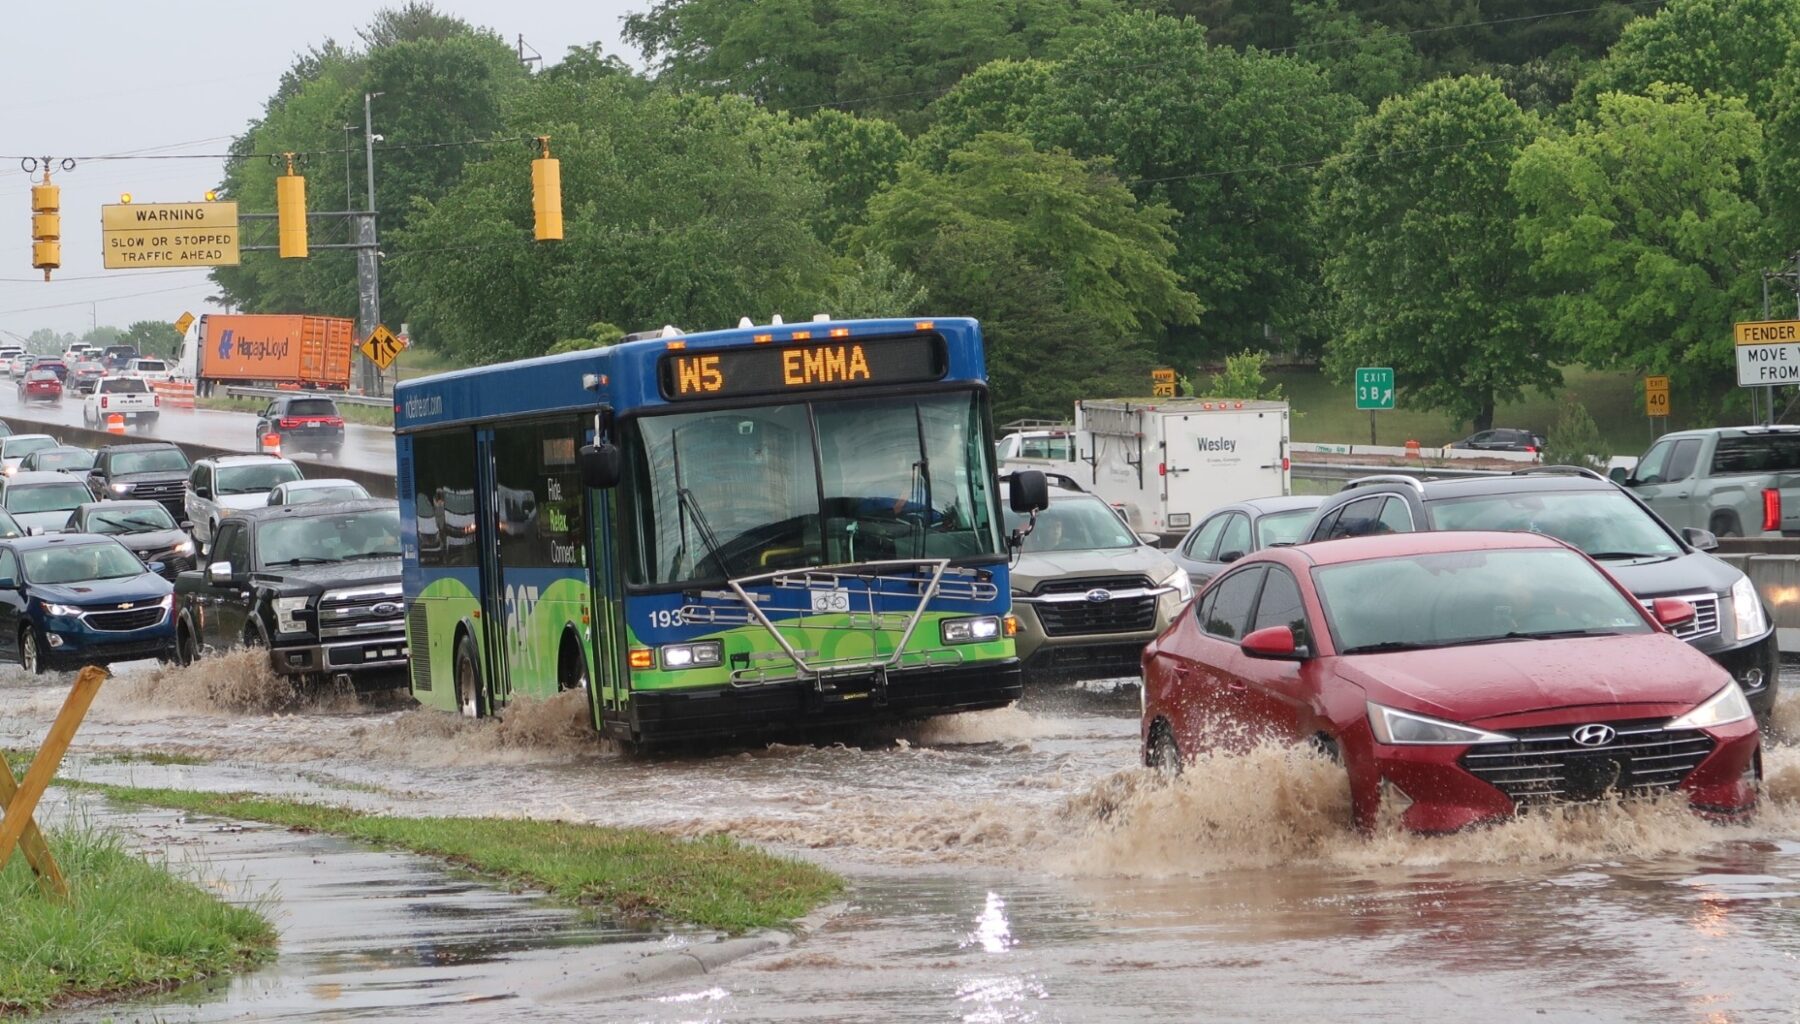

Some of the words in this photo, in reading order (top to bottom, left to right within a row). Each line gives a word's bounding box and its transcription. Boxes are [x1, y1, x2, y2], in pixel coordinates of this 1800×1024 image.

[136, 208, 205, 222] WARNING
[111, 237, 145, 248] SLOW
[151, 236, 168, 246] OR
[175, 234, 231, 246] STOPPED
[121, 251, 173, 262] TRAFFIC
[180, 249, 222, 260] AHEAD
[1744, 326, 1796, 341] FENDER
[1748, 347, 1788, 363] MOVE
[678, 356, 723, 394] W5
[783, 345, 871, 385] EMMA
[1760, 365, 1799, 380] FROM
[1363, 372, 1387, 383] EXIT
[1650, 393, 1666, 406] 40
[1197, 436, 1236, 453] Wesley
